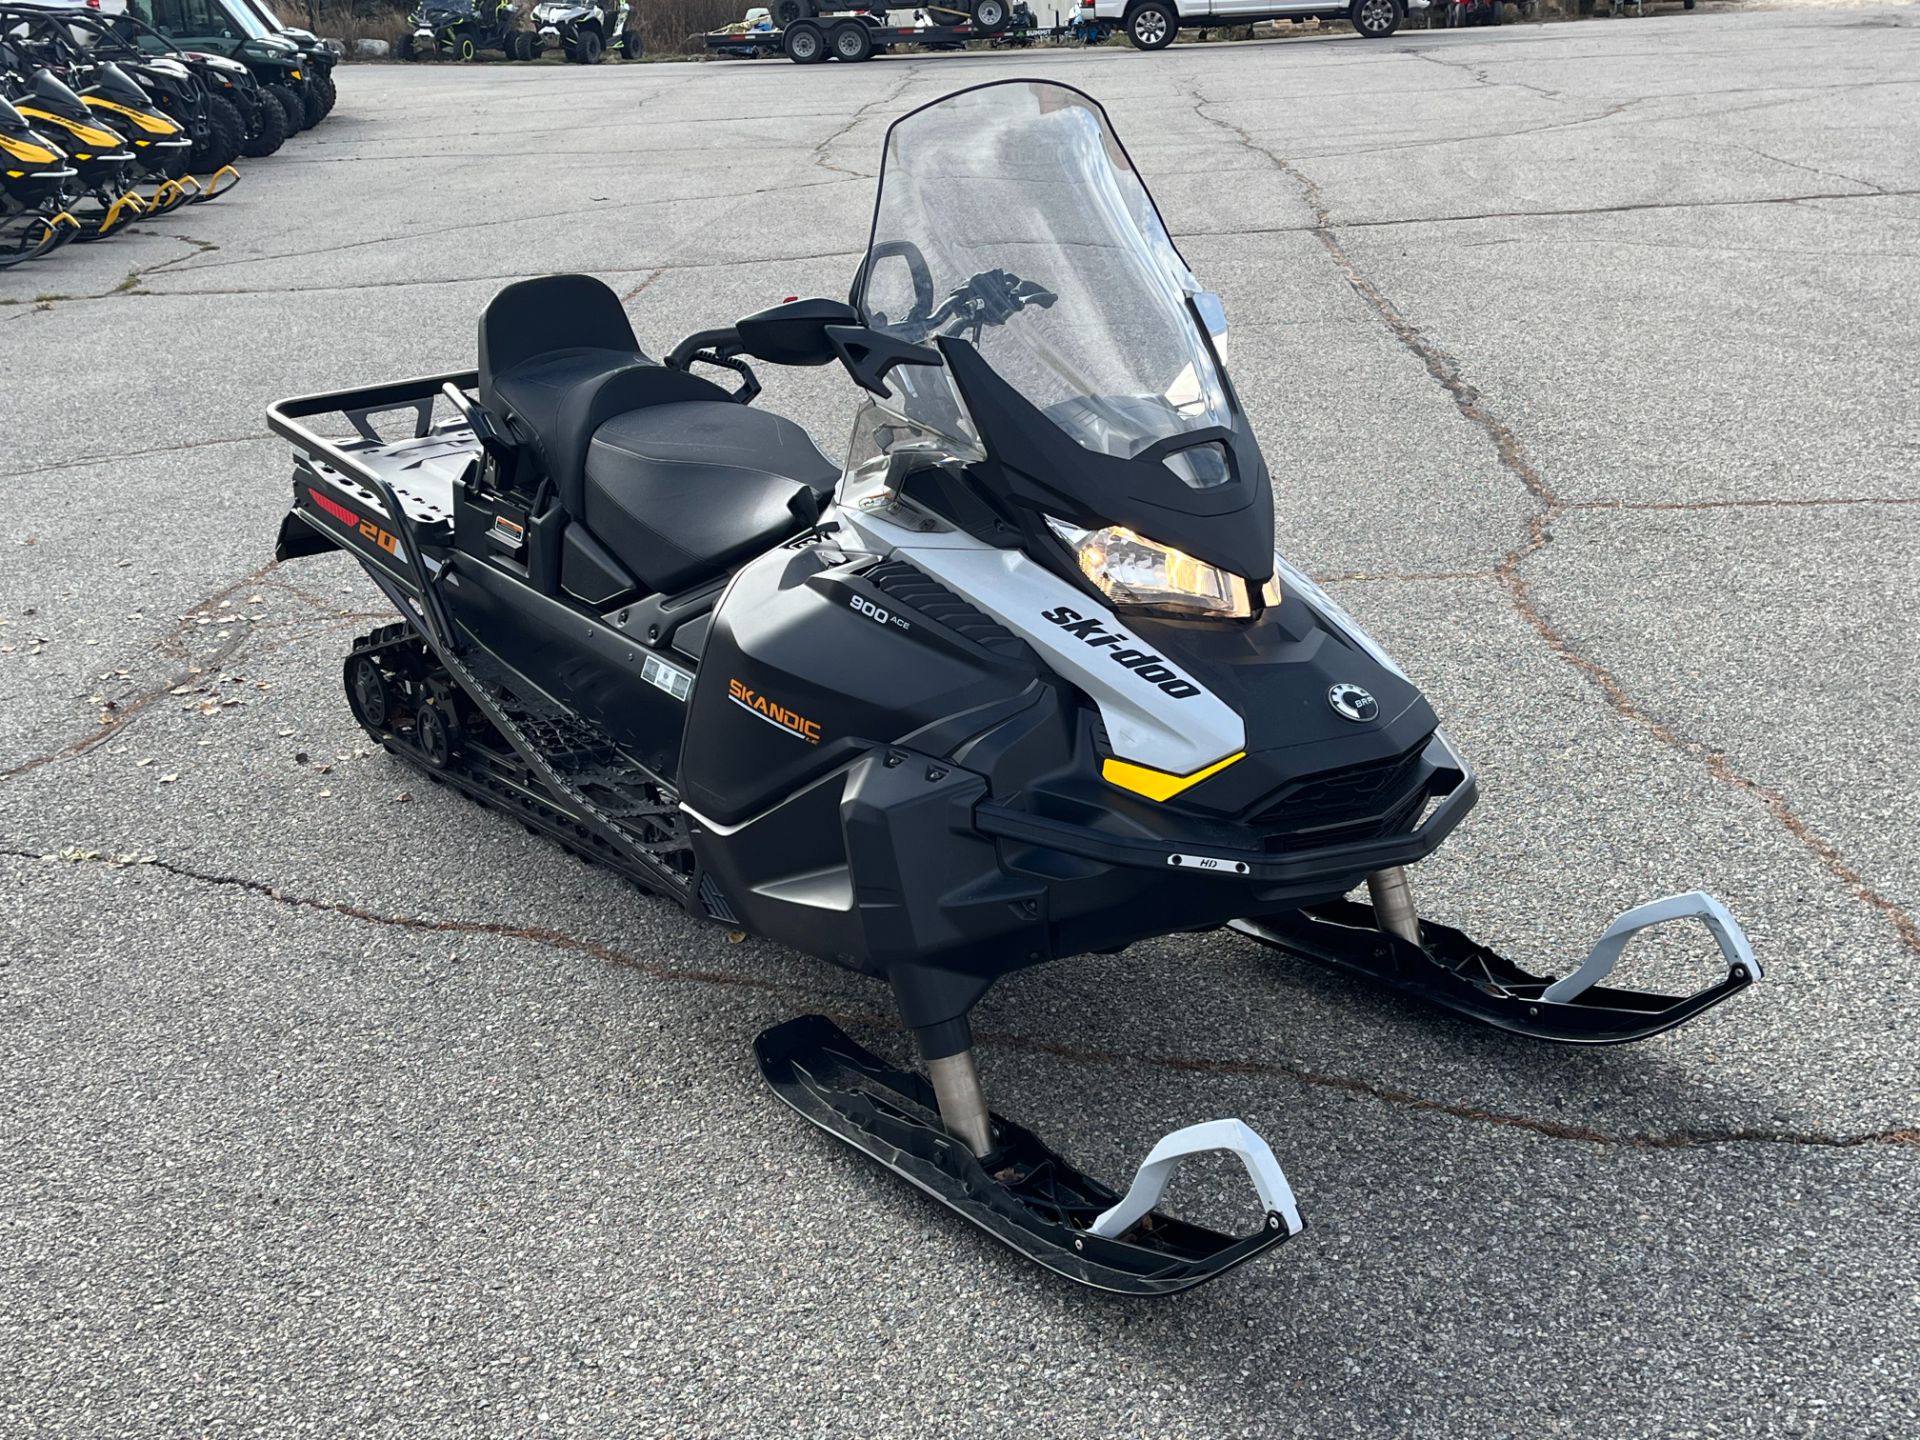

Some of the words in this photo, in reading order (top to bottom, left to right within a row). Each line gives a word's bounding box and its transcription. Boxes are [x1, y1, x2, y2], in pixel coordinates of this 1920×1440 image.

[359, 518, 397, 555] 20
[850, 594, 889, 624] 900
[890, 616, 911, 630] ACE
[729, 678, 821, 740] SKANDIC
[1354, 696, 1374, 708] BRP
[1200, 858, 1218, 868] HD
